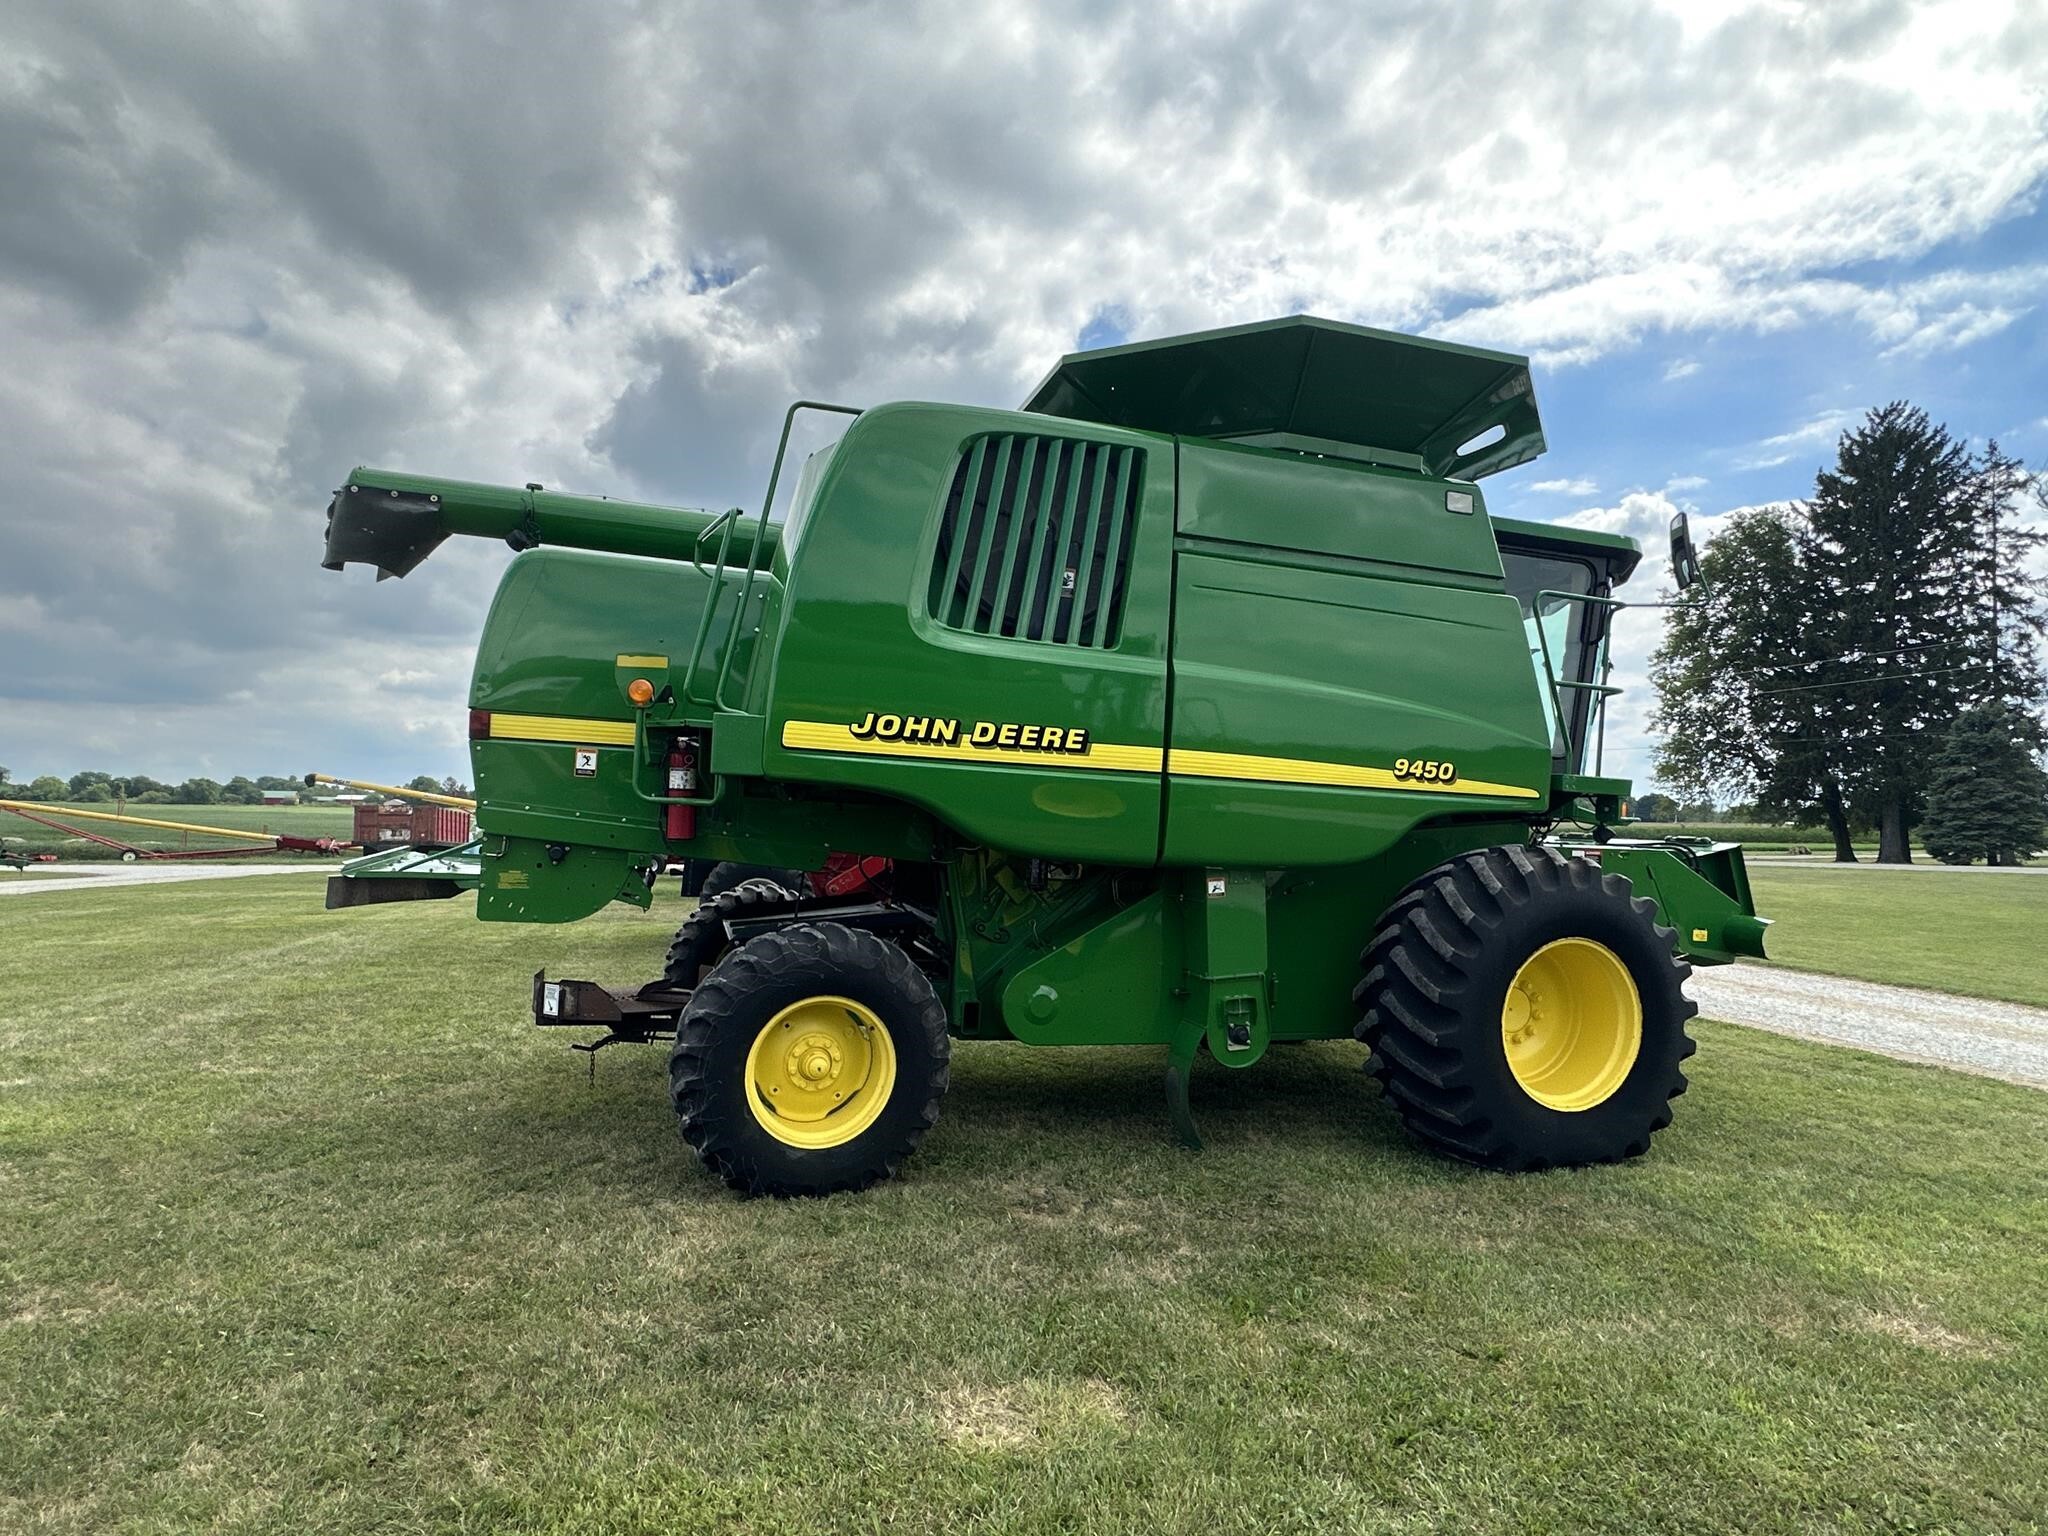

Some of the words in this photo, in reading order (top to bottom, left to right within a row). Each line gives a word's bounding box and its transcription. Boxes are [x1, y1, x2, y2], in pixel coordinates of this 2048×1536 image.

[850, 712, 961, 744] JOHN
[971, 720, 1088, 752] DEERE
[1393, 757, 1456, 783] 9450
